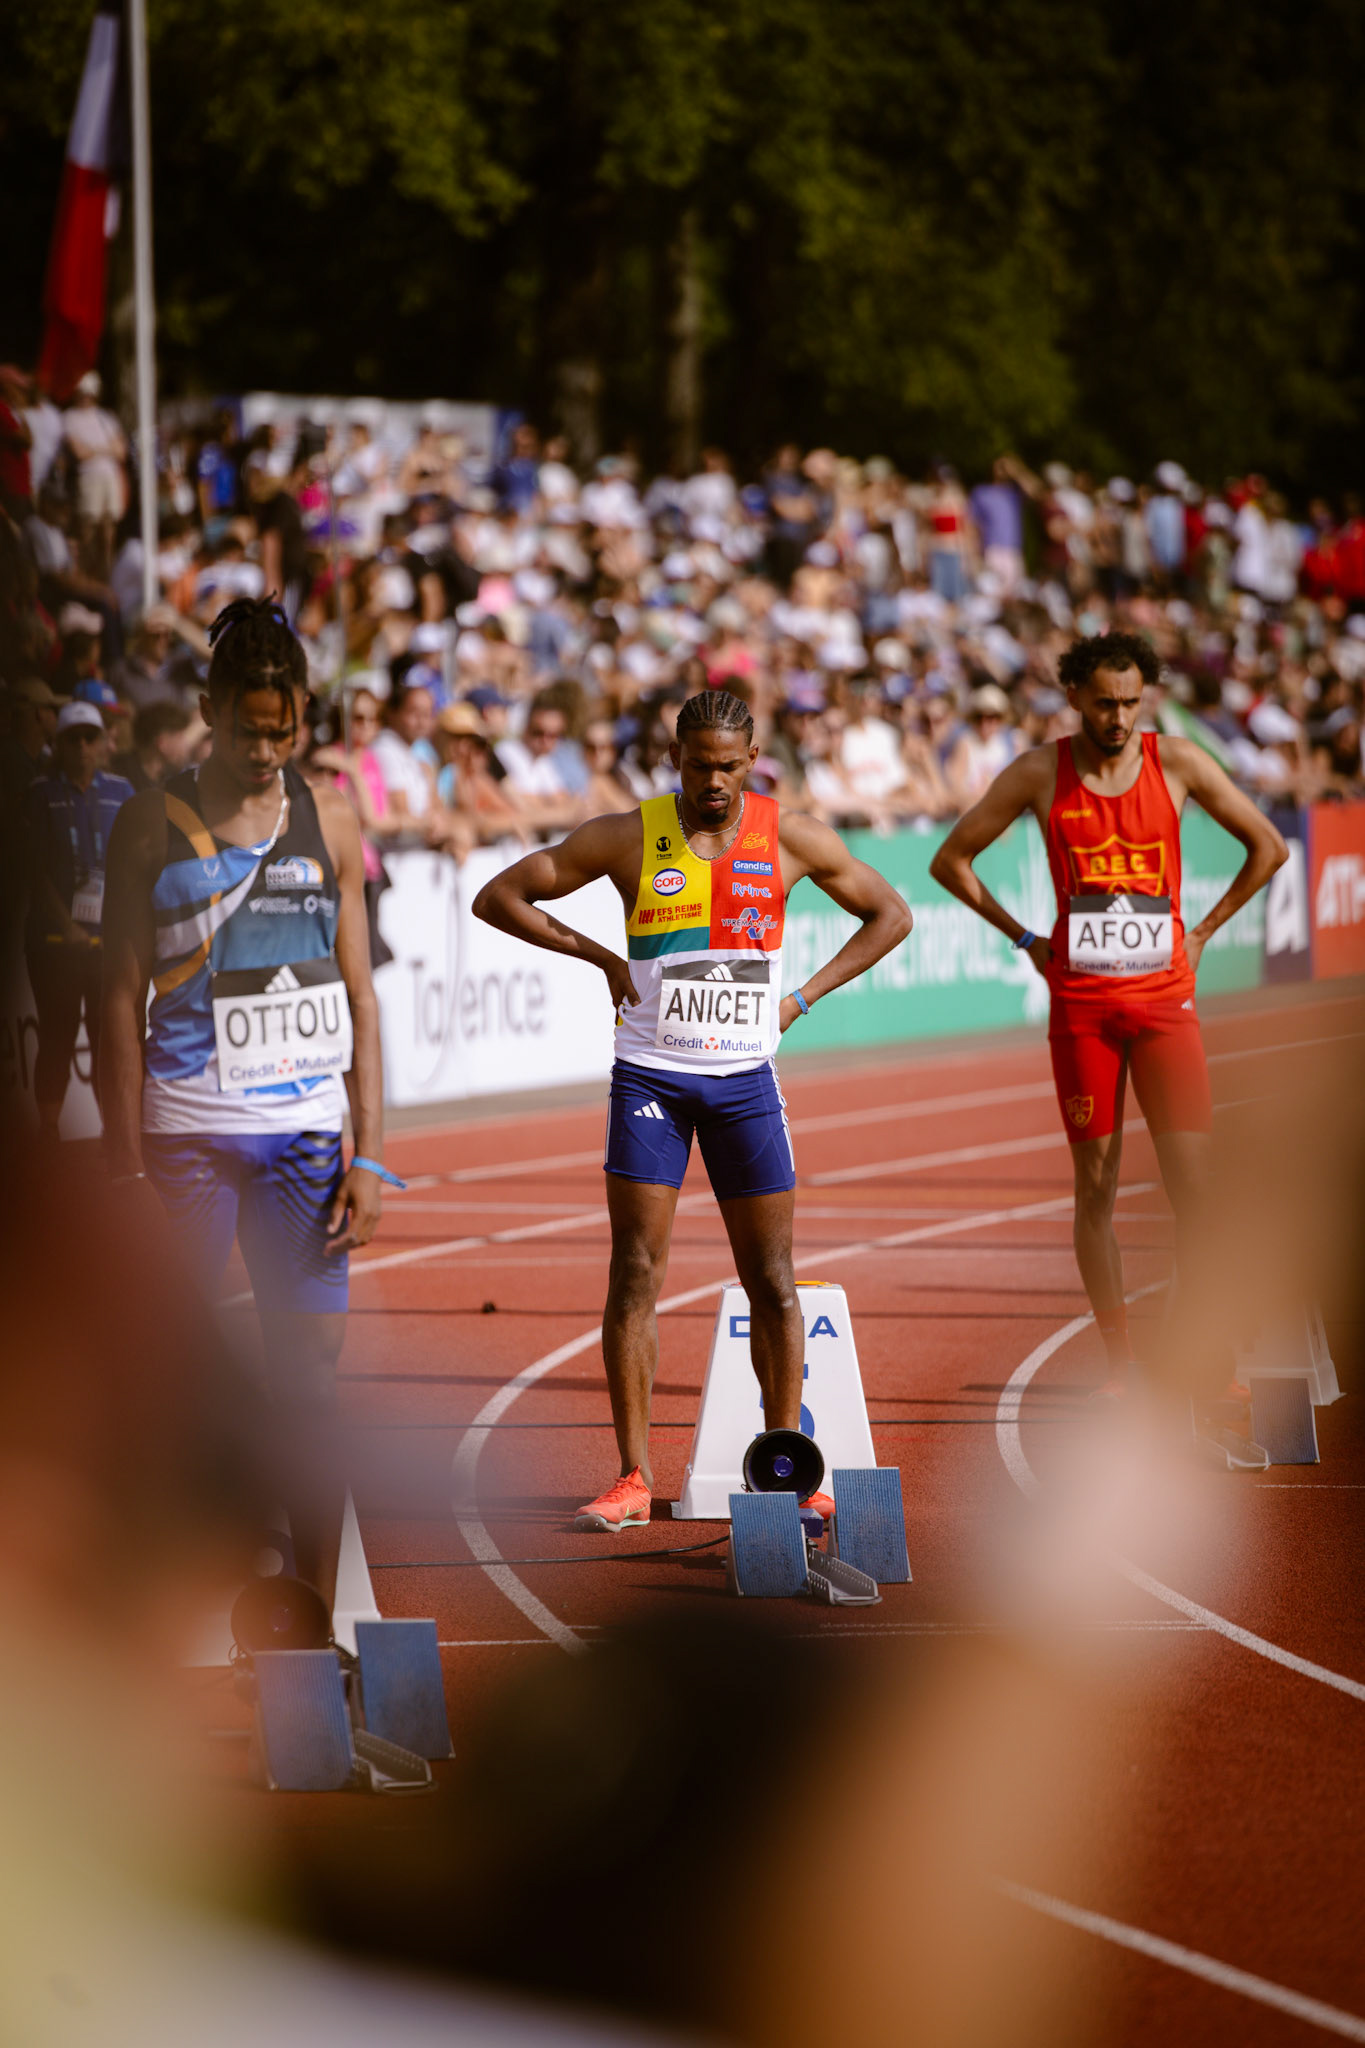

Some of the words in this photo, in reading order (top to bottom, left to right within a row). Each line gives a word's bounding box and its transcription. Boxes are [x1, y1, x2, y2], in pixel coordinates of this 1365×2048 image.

[1089, 853, 1146, 875] BEC
[654, 876, 684, 888] cora
[657, 907, 673, 916] EFS
[675, 903, 703, 913] REIMS
[657, 911, 702, 923] ATHLETISME
[1077, 920, 1164, 949] AFOY
[664, 987, 766, 1025] ANICET
[226, 994, 341, 1049] OTTOU
[663, 1034, 704, 1049] Crédit
[720, 1039, 762, 1052] Mutuel
[229, 1063, 276, 1082] Crédit
[295, 1051, 343, 1071] Mutuel
